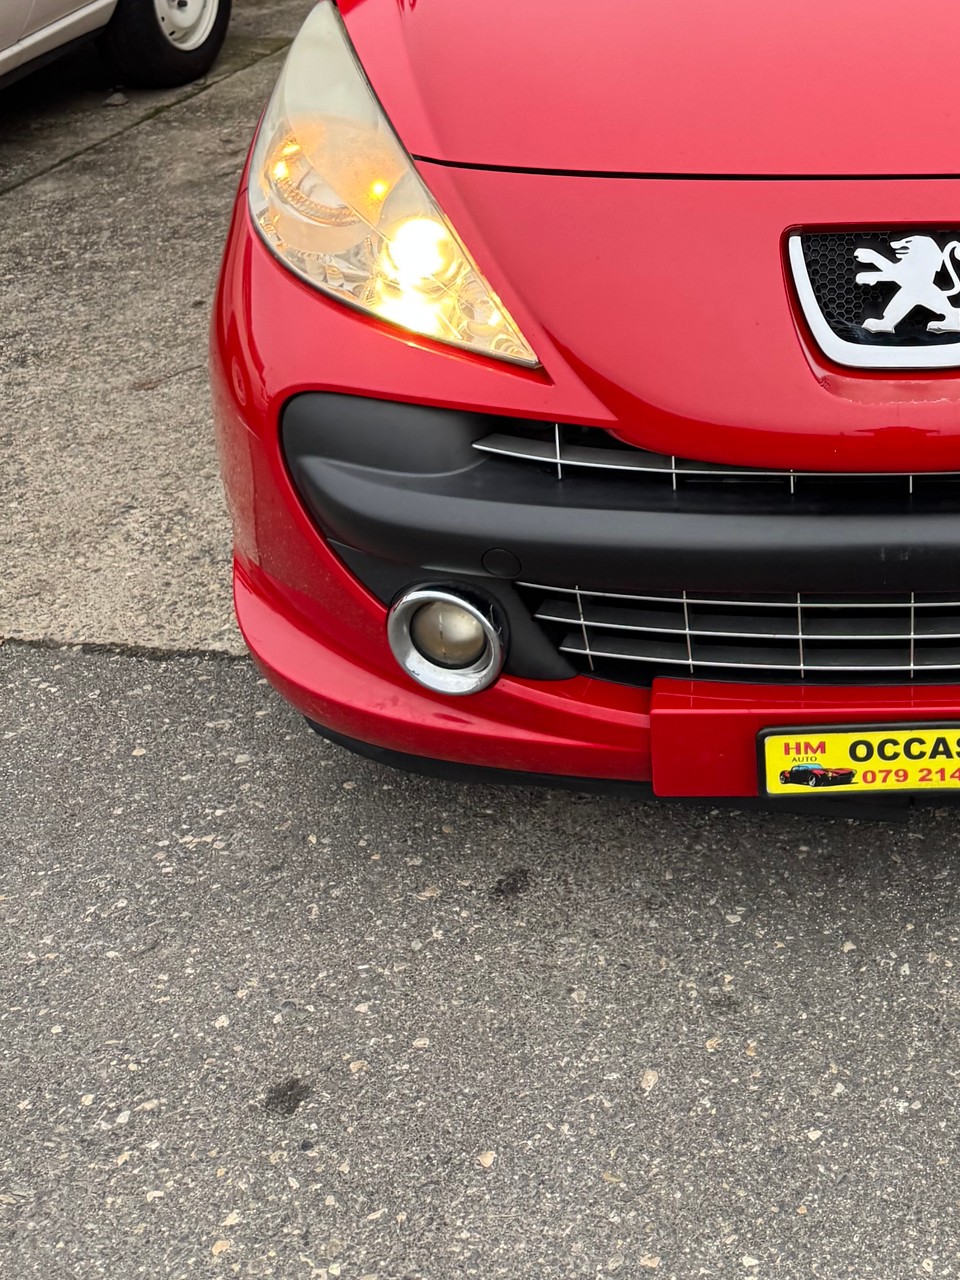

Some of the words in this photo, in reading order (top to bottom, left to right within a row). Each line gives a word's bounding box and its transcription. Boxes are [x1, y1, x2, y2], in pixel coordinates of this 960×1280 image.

[783, 741, 826, 756] HM
[791, 755, 818, 763] AUTO
[862, 768, 909, 784] 079
